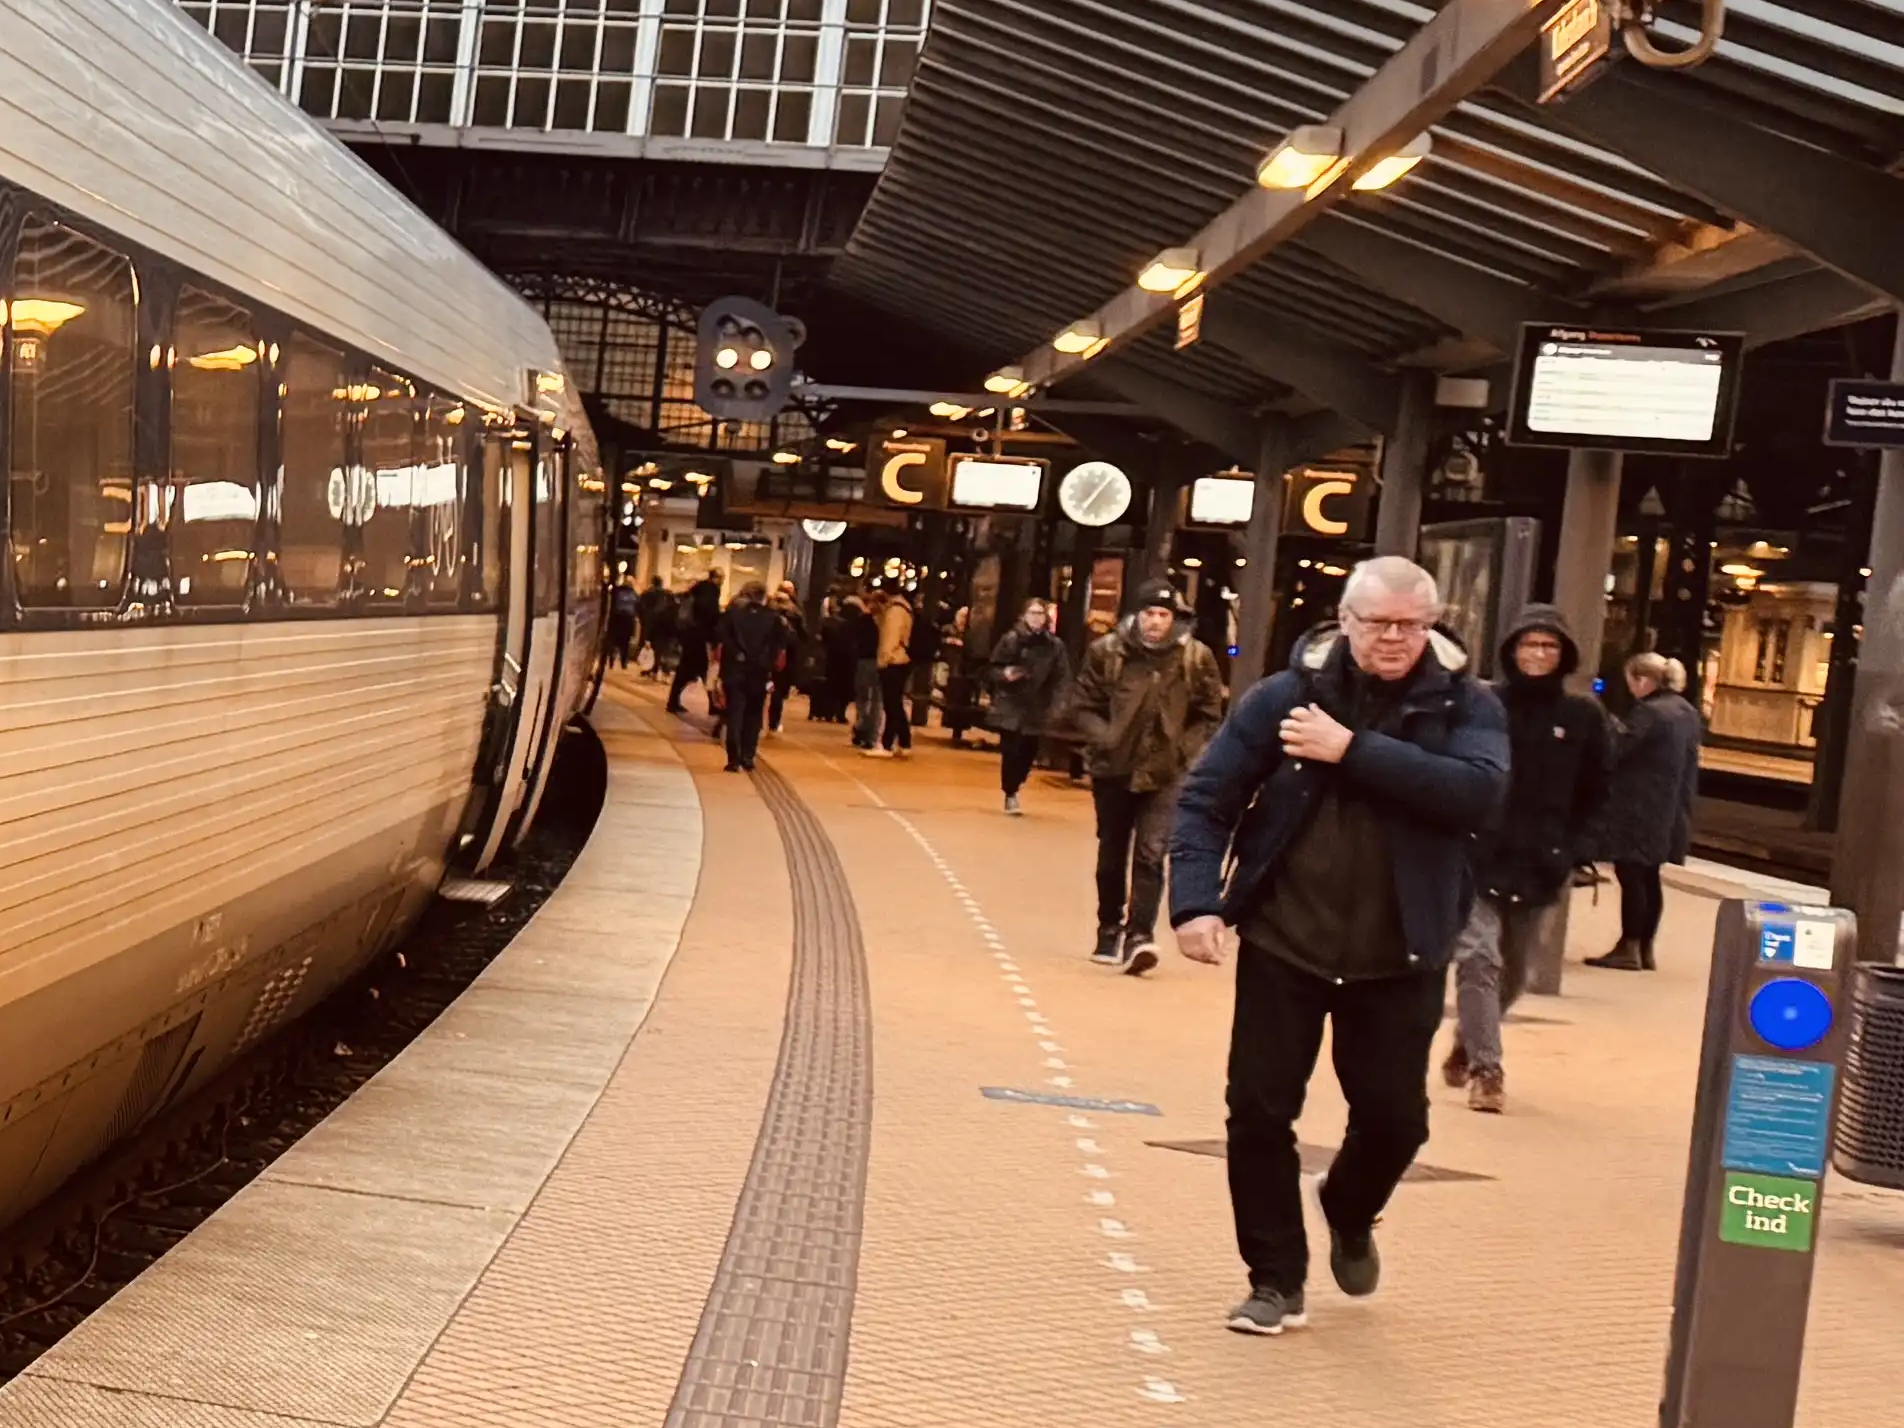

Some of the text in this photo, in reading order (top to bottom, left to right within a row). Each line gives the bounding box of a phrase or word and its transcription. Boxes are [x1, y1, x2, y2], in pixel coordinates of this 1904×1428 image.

[882, 452, 926, 504] C
[1303, 481, 1351, 535] C
[1728, 1185, 1810, 1214] Check
[1745, 1210, 1788, 1234] ind
